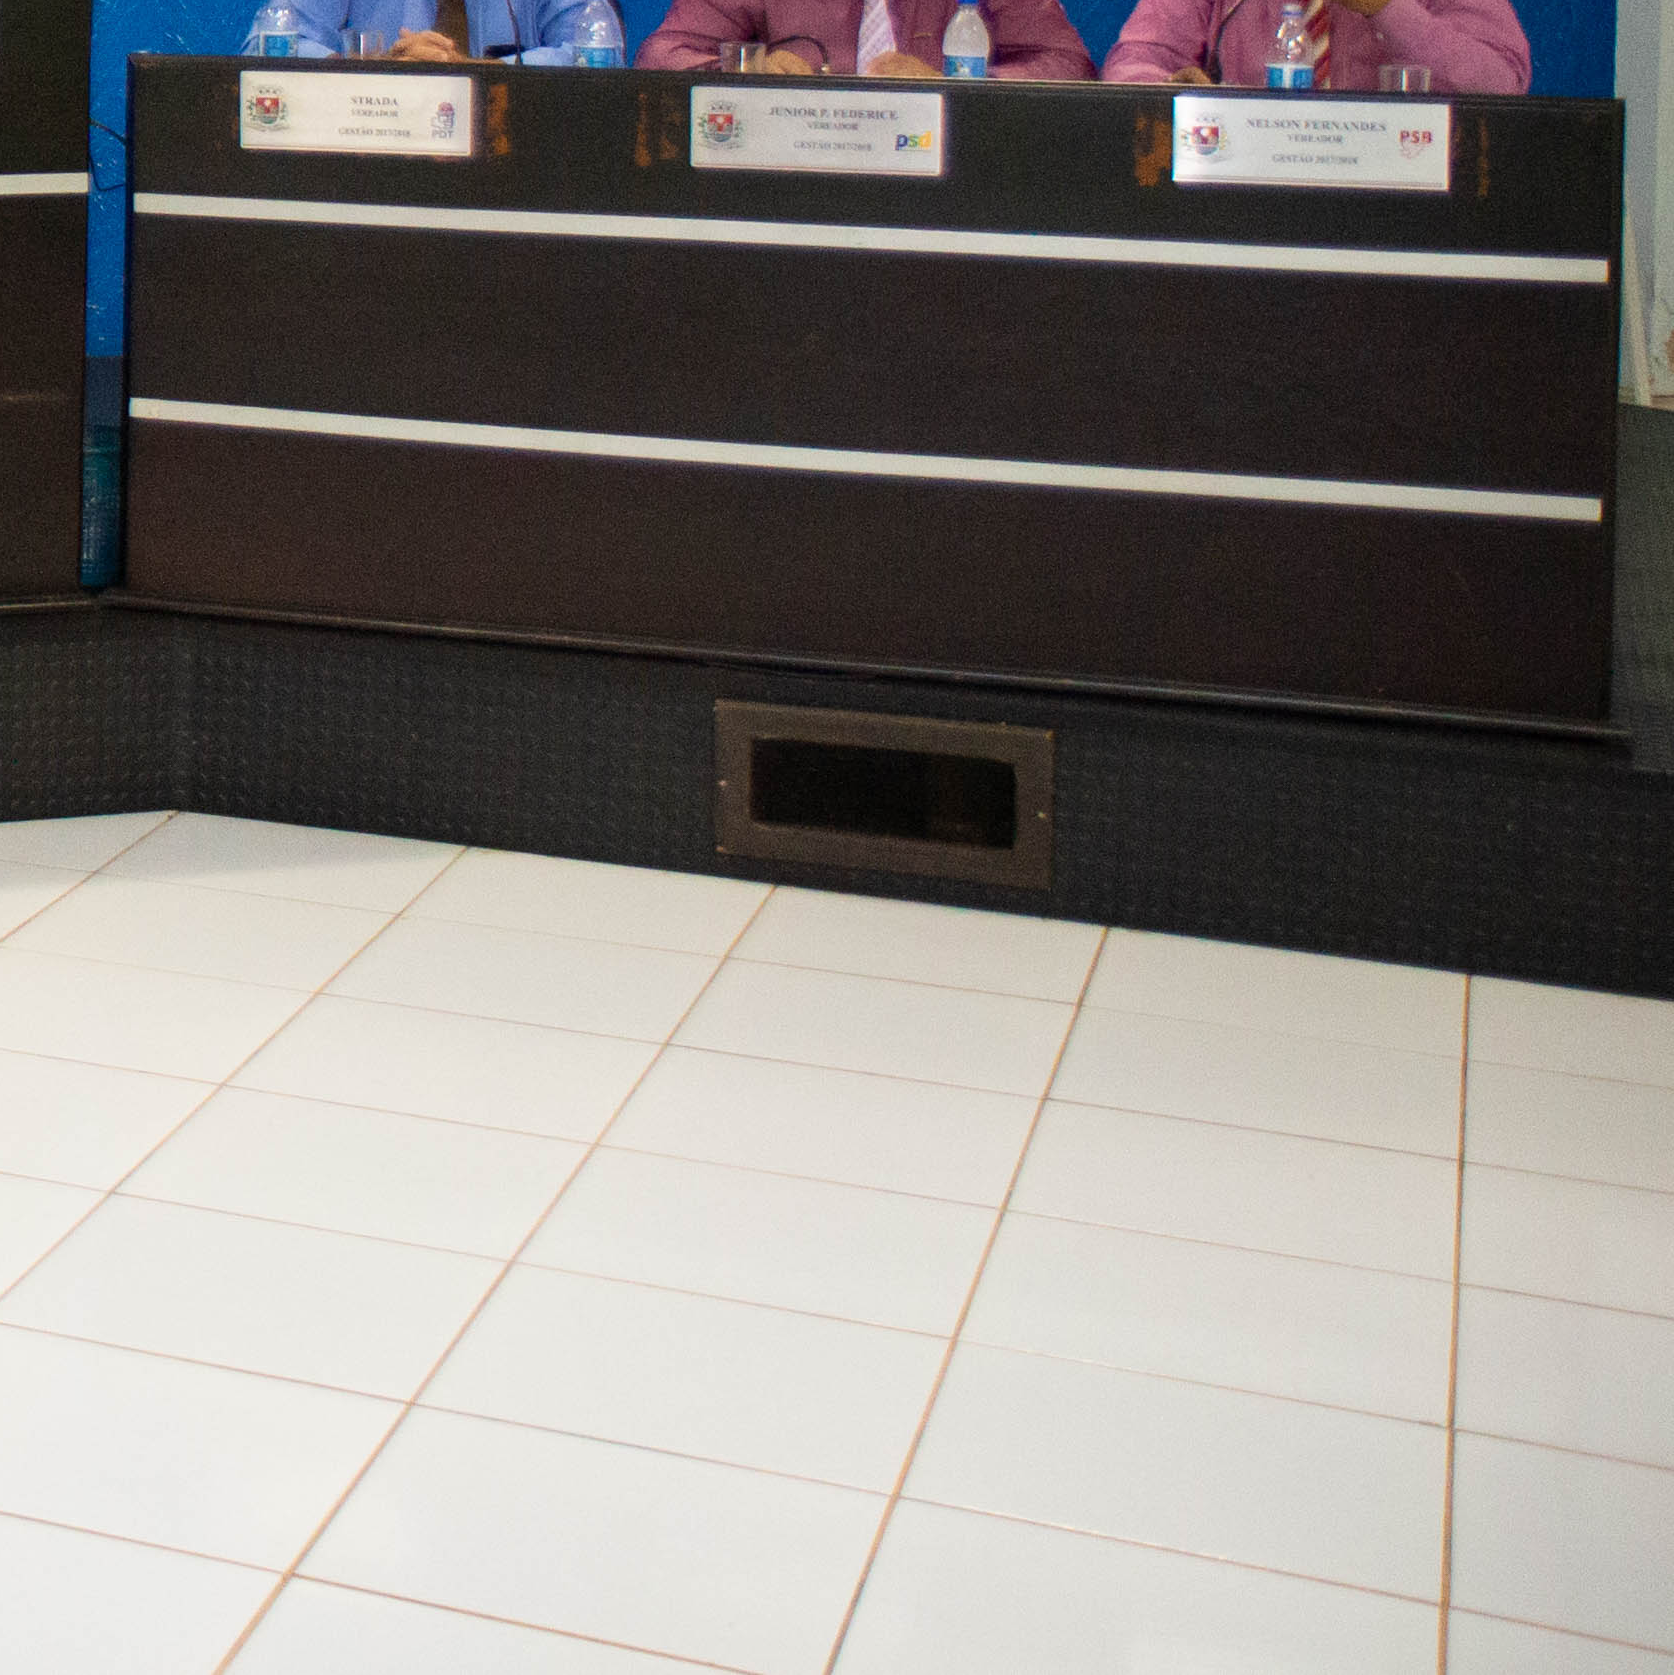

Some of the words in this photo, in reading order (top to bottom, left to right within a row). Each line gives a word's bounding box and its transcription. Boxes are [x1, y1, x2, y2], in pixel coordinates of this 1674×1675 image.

[351, 95, 398, 107] STRADA
[1247, 117, 1301, 129] NELSON
[1304, 119, 1387, 132] FERNANDES
[432, 130, 454, 139] PDT
[1400, 130, 1433, 144] PSB
